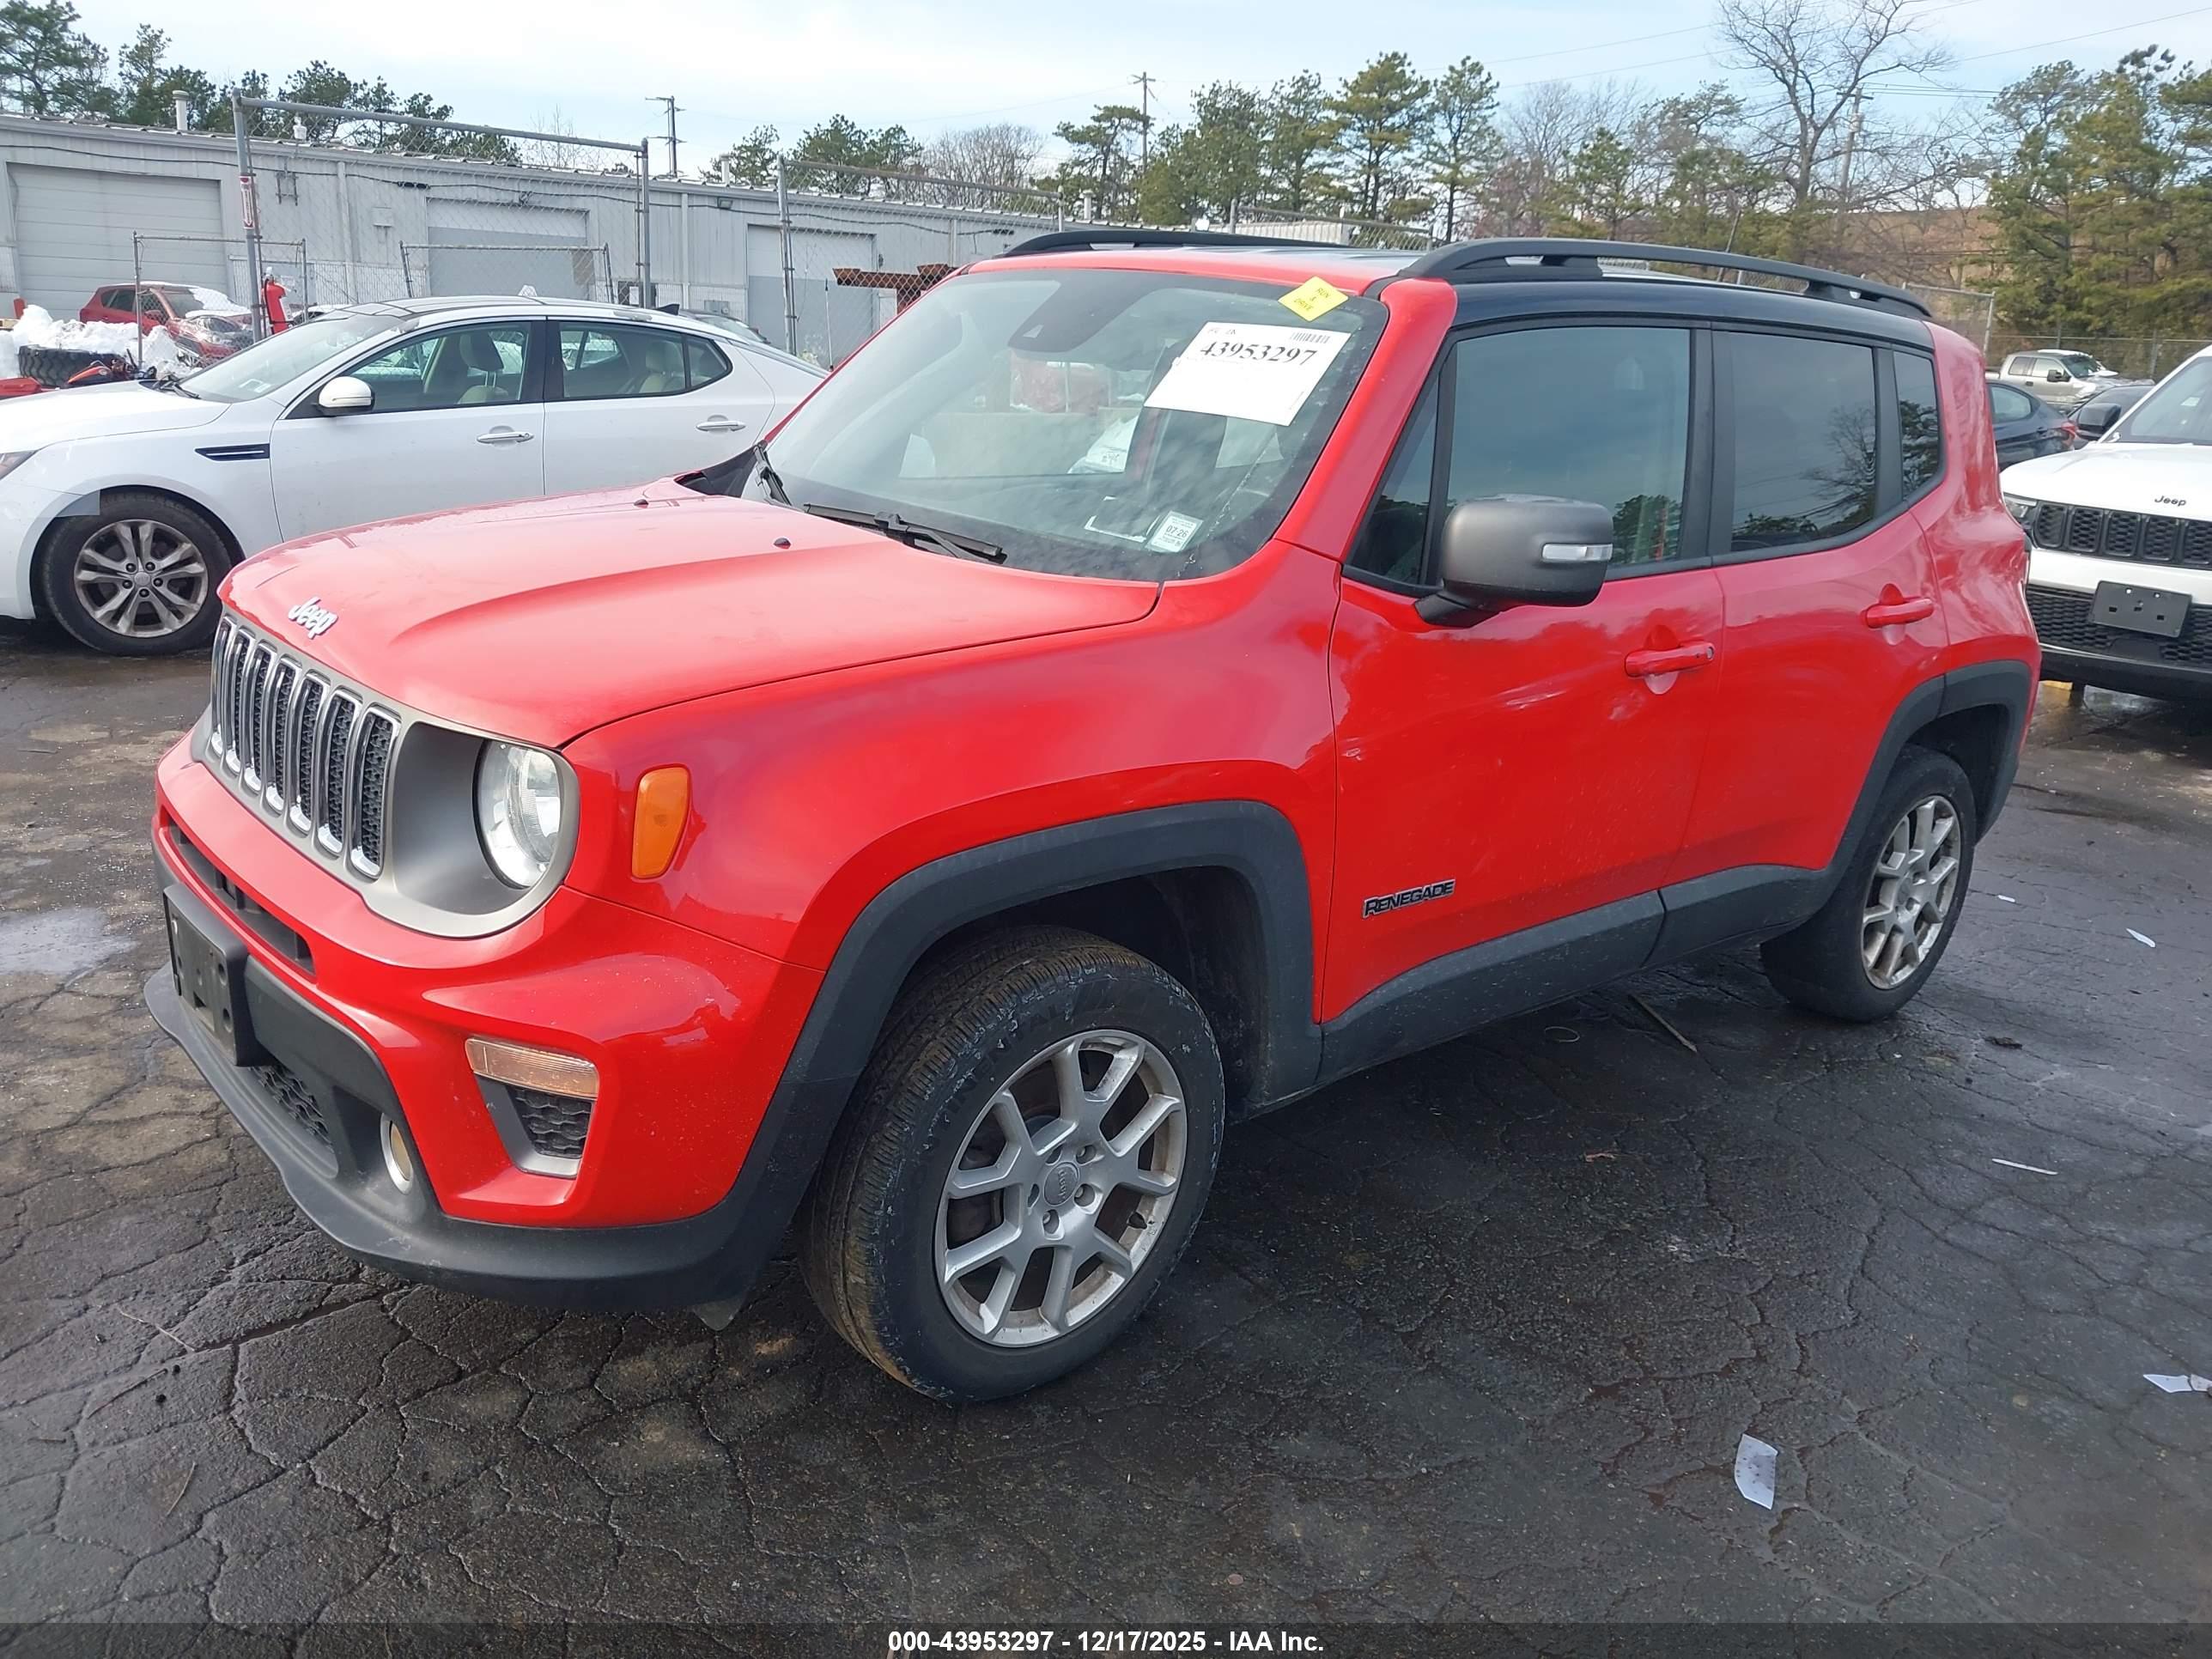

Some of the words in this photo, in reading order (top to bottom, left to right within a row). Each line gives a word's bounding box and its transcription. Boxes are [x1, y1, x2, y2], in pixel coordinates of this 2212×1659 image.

[1316, 288, 1330, 298] RUN
[1293, 298, 1314, 311] DRIVE
[1200, 341, 1317, 366] 43953297
[2154, 495, 2187, 507] Jeep
[288, 595, 339, 641] Jeep
[1363, 878, 1456, 919] RENEGADE
